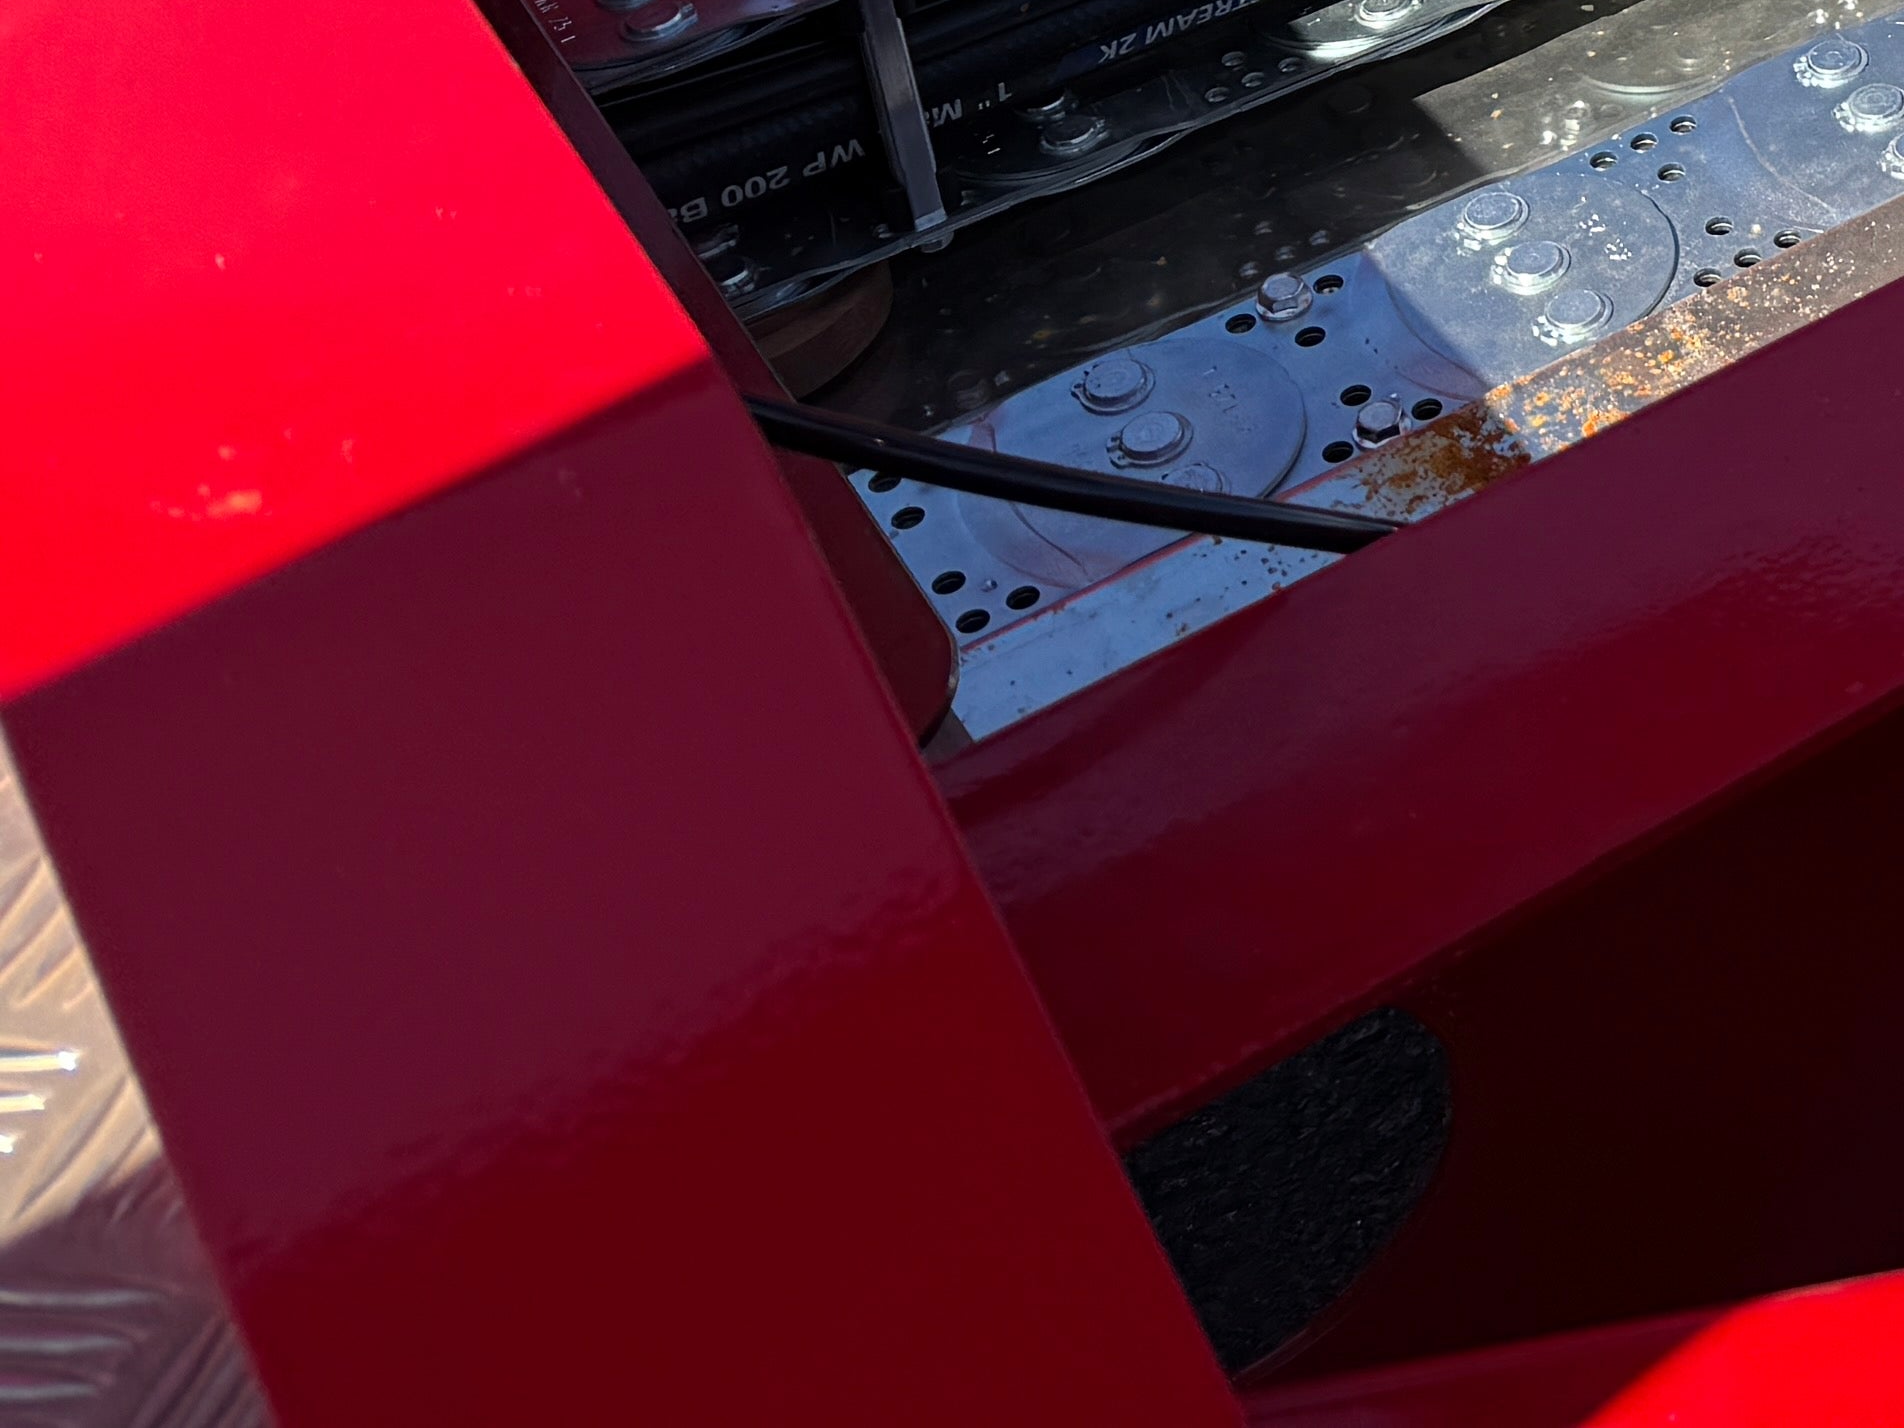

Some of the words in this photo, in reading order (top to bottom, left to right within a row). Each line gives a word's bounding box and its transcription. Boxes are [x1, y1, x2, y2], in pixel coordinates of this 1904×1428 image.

[1098, 30, 1140, 64] 2K
[803, 138, 866, 178] WP
[720, 164, 789, 209] 200
